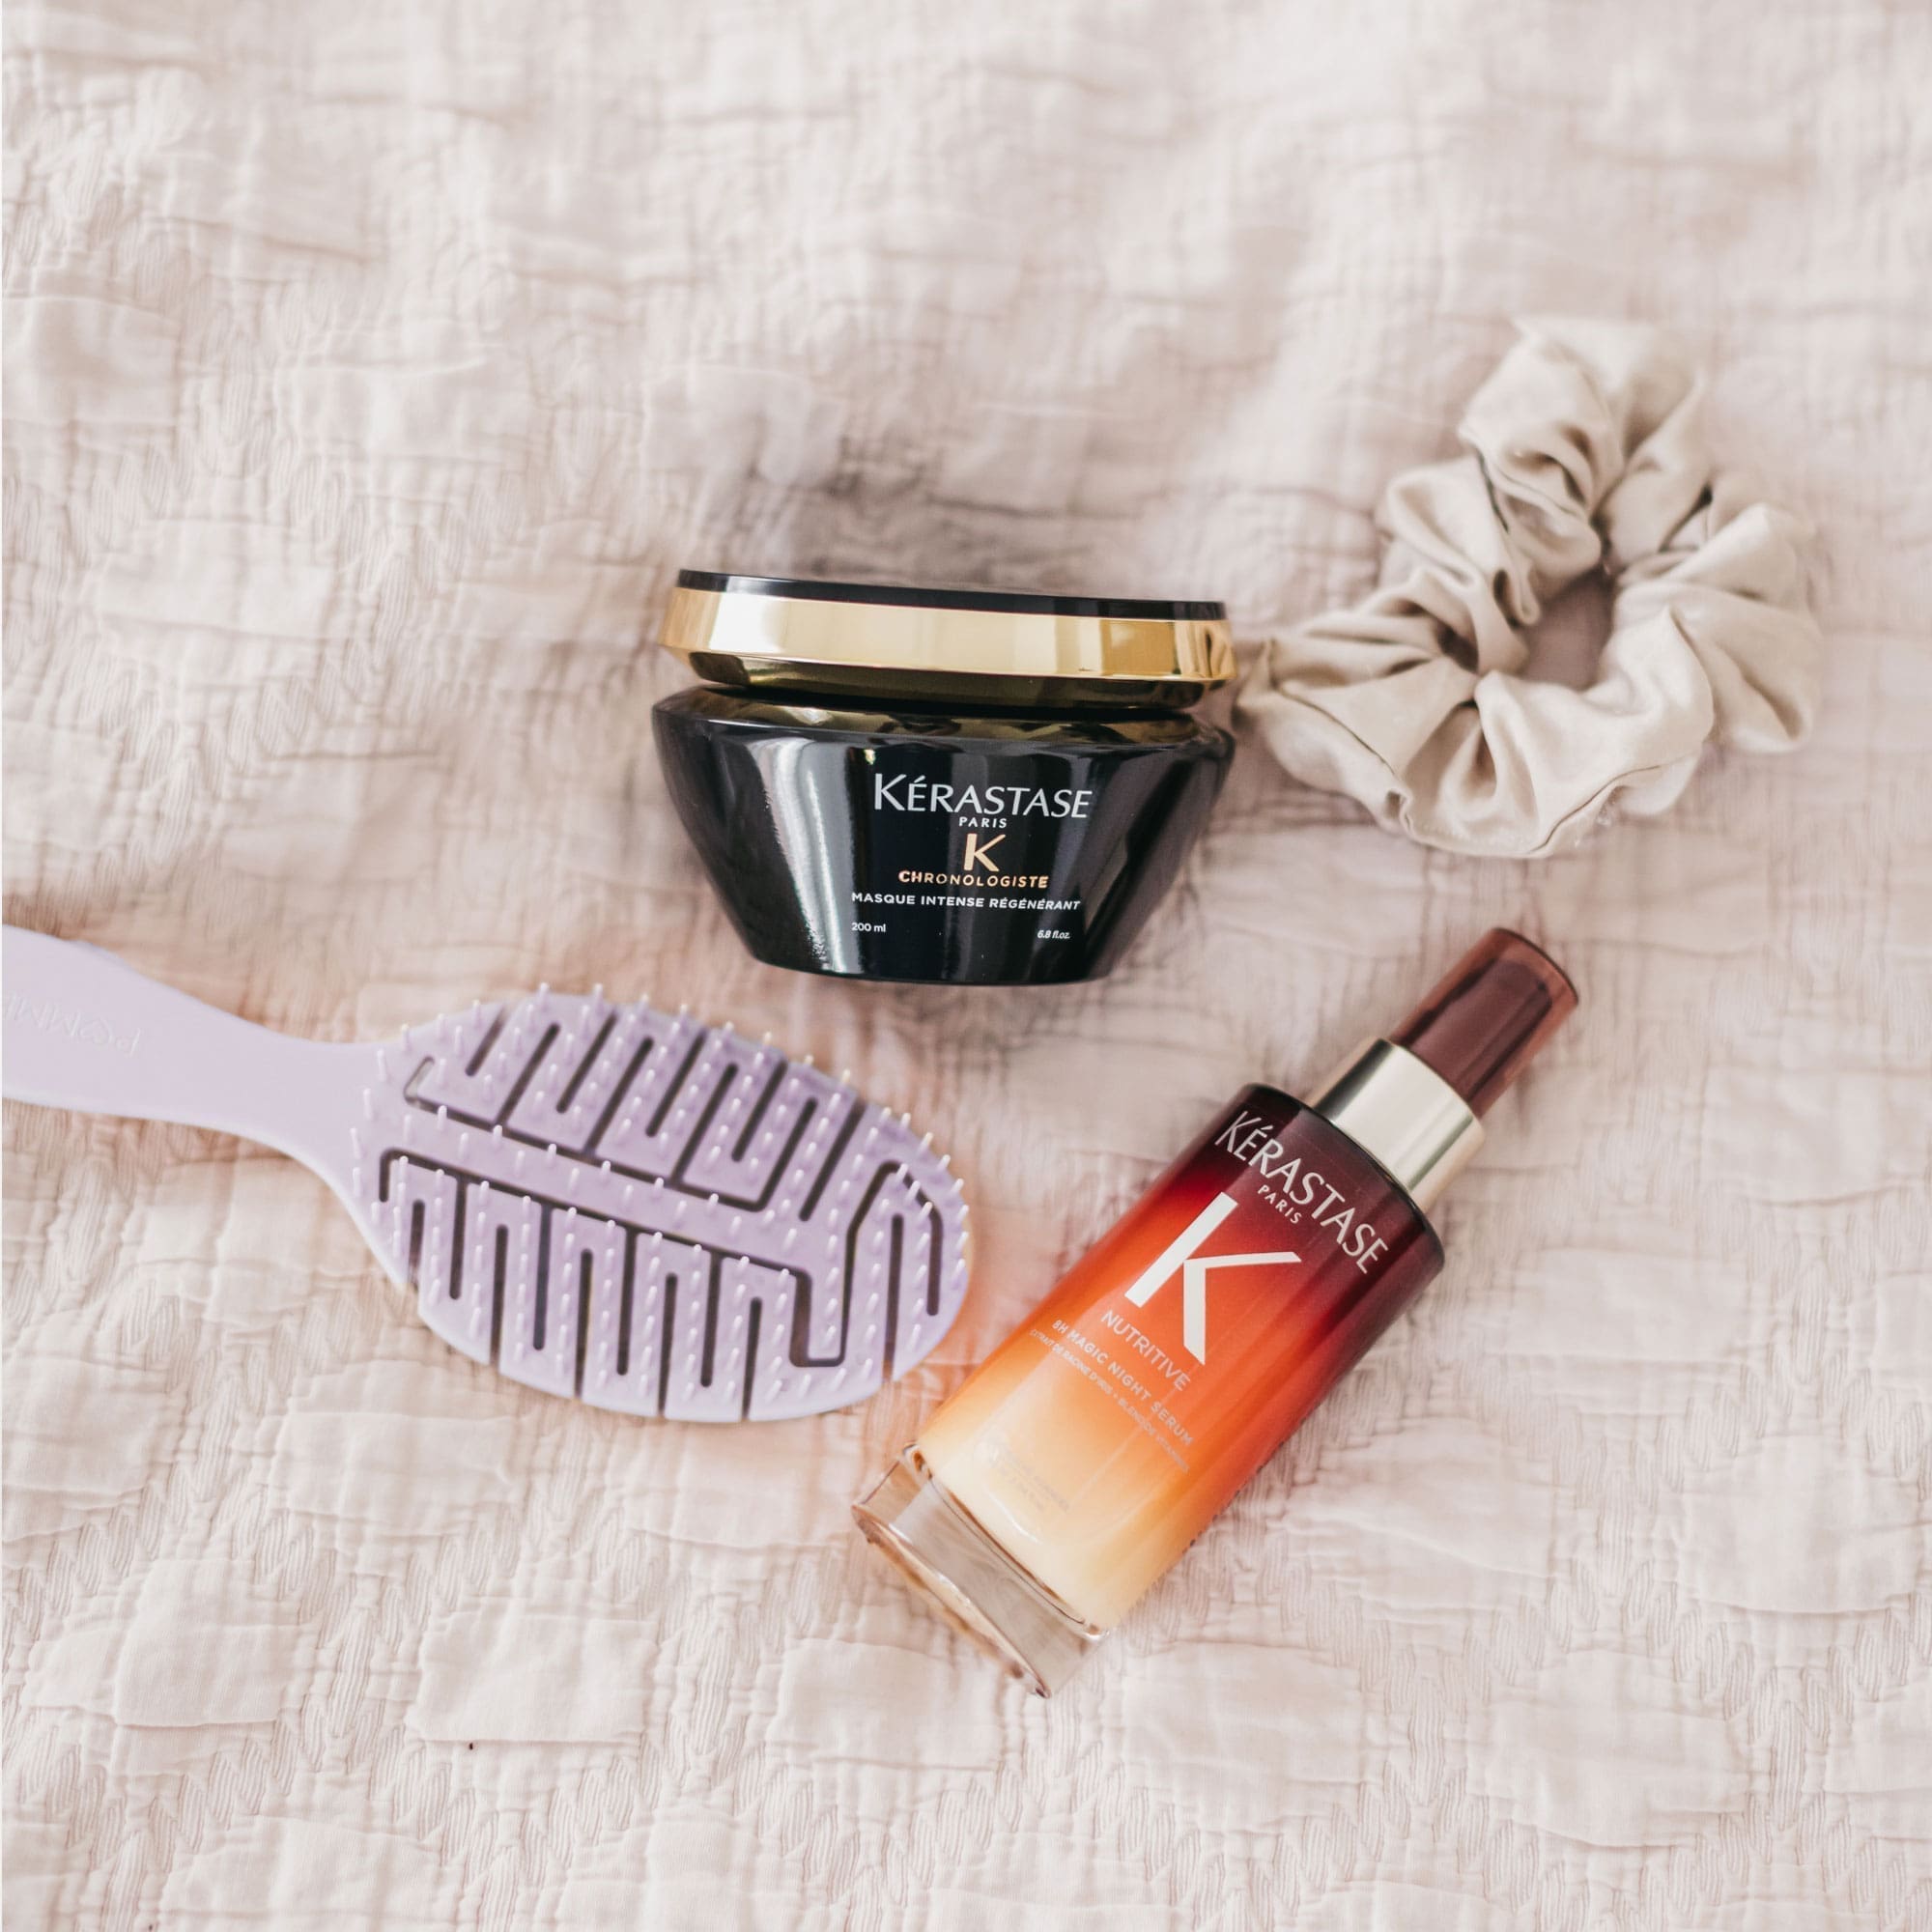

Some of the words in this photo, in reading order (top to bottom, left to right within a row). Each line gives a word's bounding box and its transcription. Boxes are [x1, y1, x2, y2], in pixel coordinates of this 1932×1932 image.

[874, 773, 1094, 818] KÉRASTASE
[958, 816, 1008, 829] PARIS
[963, 833, 1007, 872] K
[898, 870, 1050, 889] CHRONOLOGISTE
[851, 893, 916, 905] MASQUE
[921, 895, 984, 908] INTENSE
[989, 897, 1081, 911] RÉGÉNÉRANT
[851, 923, 872, 932] 200
[873, 923, 887, 933] ml
[1037, 929, 1051, 939] 6.8
[1214, 1110, 1388, 1274] KÉRASTASE
[1257, 1184, 1302, 1225] PARIS
[1124, 1191, 1302, 1365] K
[1100, 1310, 1191, 1392] NUTRITIVE
[1052, 1320, 1068, 1333] 8H
[1066, 1329, 1109, 1364] MAGIC
[1108, 1361, 1151, 1401] NIGHT
[1151, 1402, 1194, 1446] SERUM
